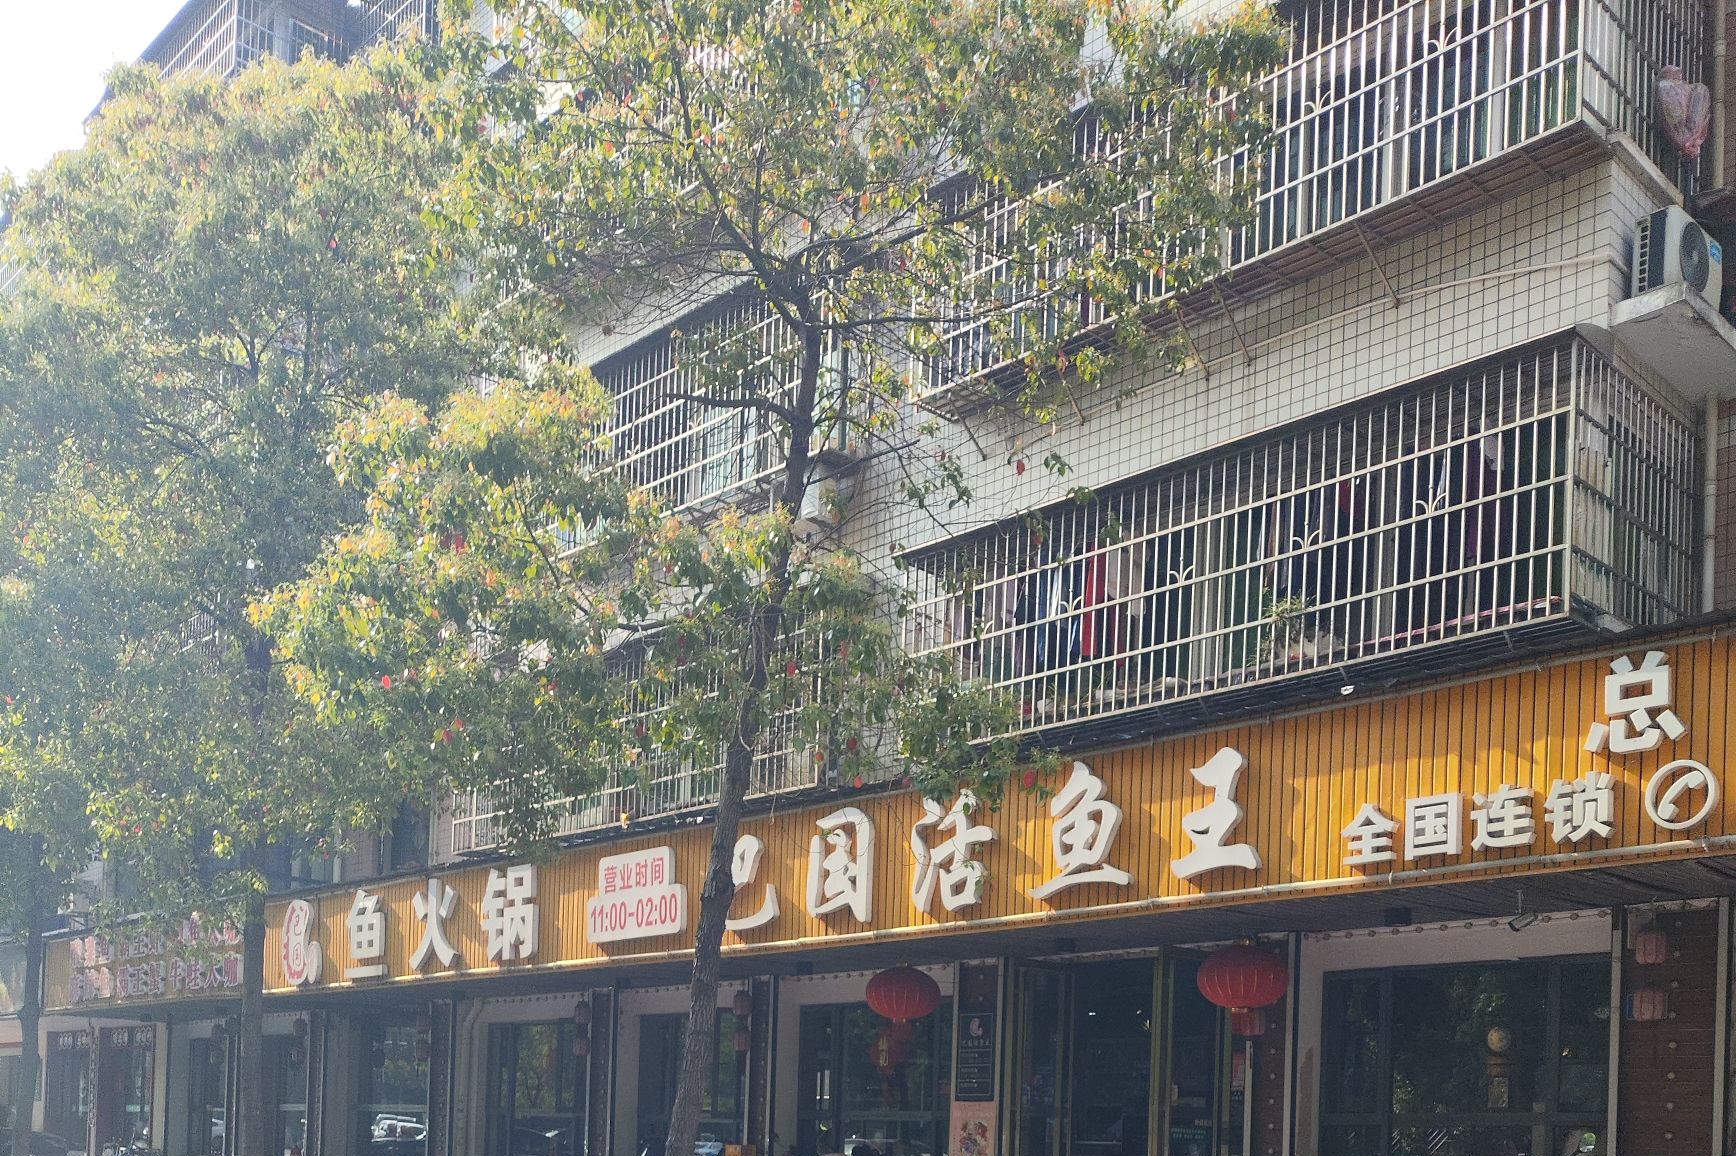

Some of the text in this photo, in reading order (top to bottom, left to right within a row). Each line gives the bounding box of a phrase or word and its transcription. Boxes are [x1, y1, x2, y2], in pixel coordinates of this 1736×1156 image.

[1583, 650, 1688, 754] 总
[1341, 771, 1616, 866] 全国连锁
[344, 863, 539, 979] 鱼火锅
[590, 893, 678, 934] 11:00-02:00
[604, 856, 664, 894] 营业时间
